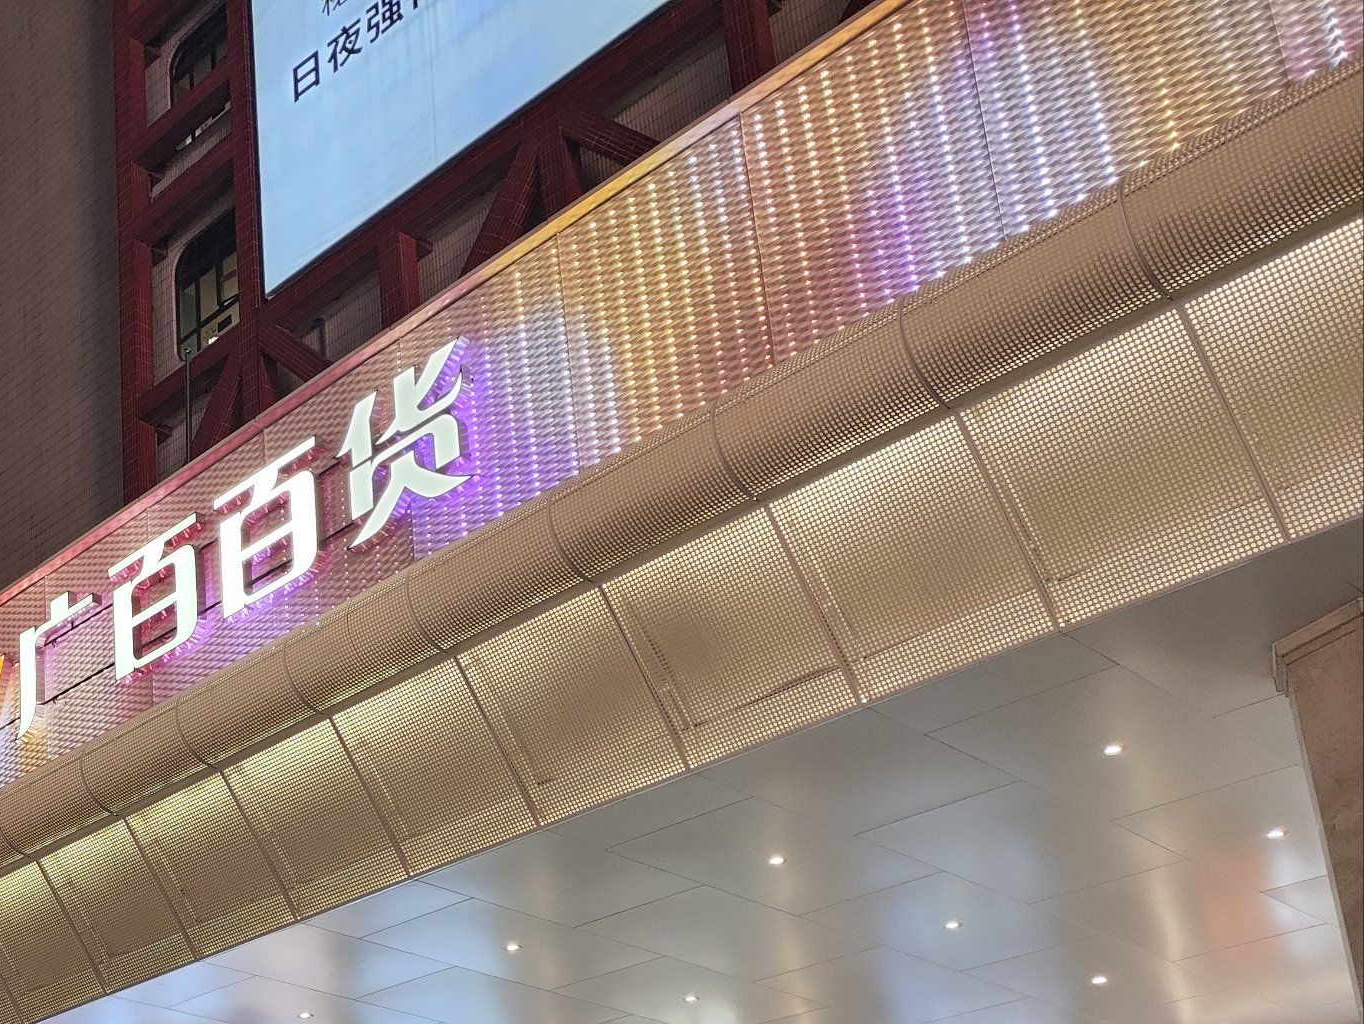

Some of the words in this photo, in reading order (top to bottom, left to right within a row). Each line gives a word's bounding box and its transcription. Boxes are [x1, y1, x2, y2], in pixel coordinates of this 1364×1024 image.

[292, 0, 430, 103] 日夜强
[15, 337, 474, 740] 广百百货
